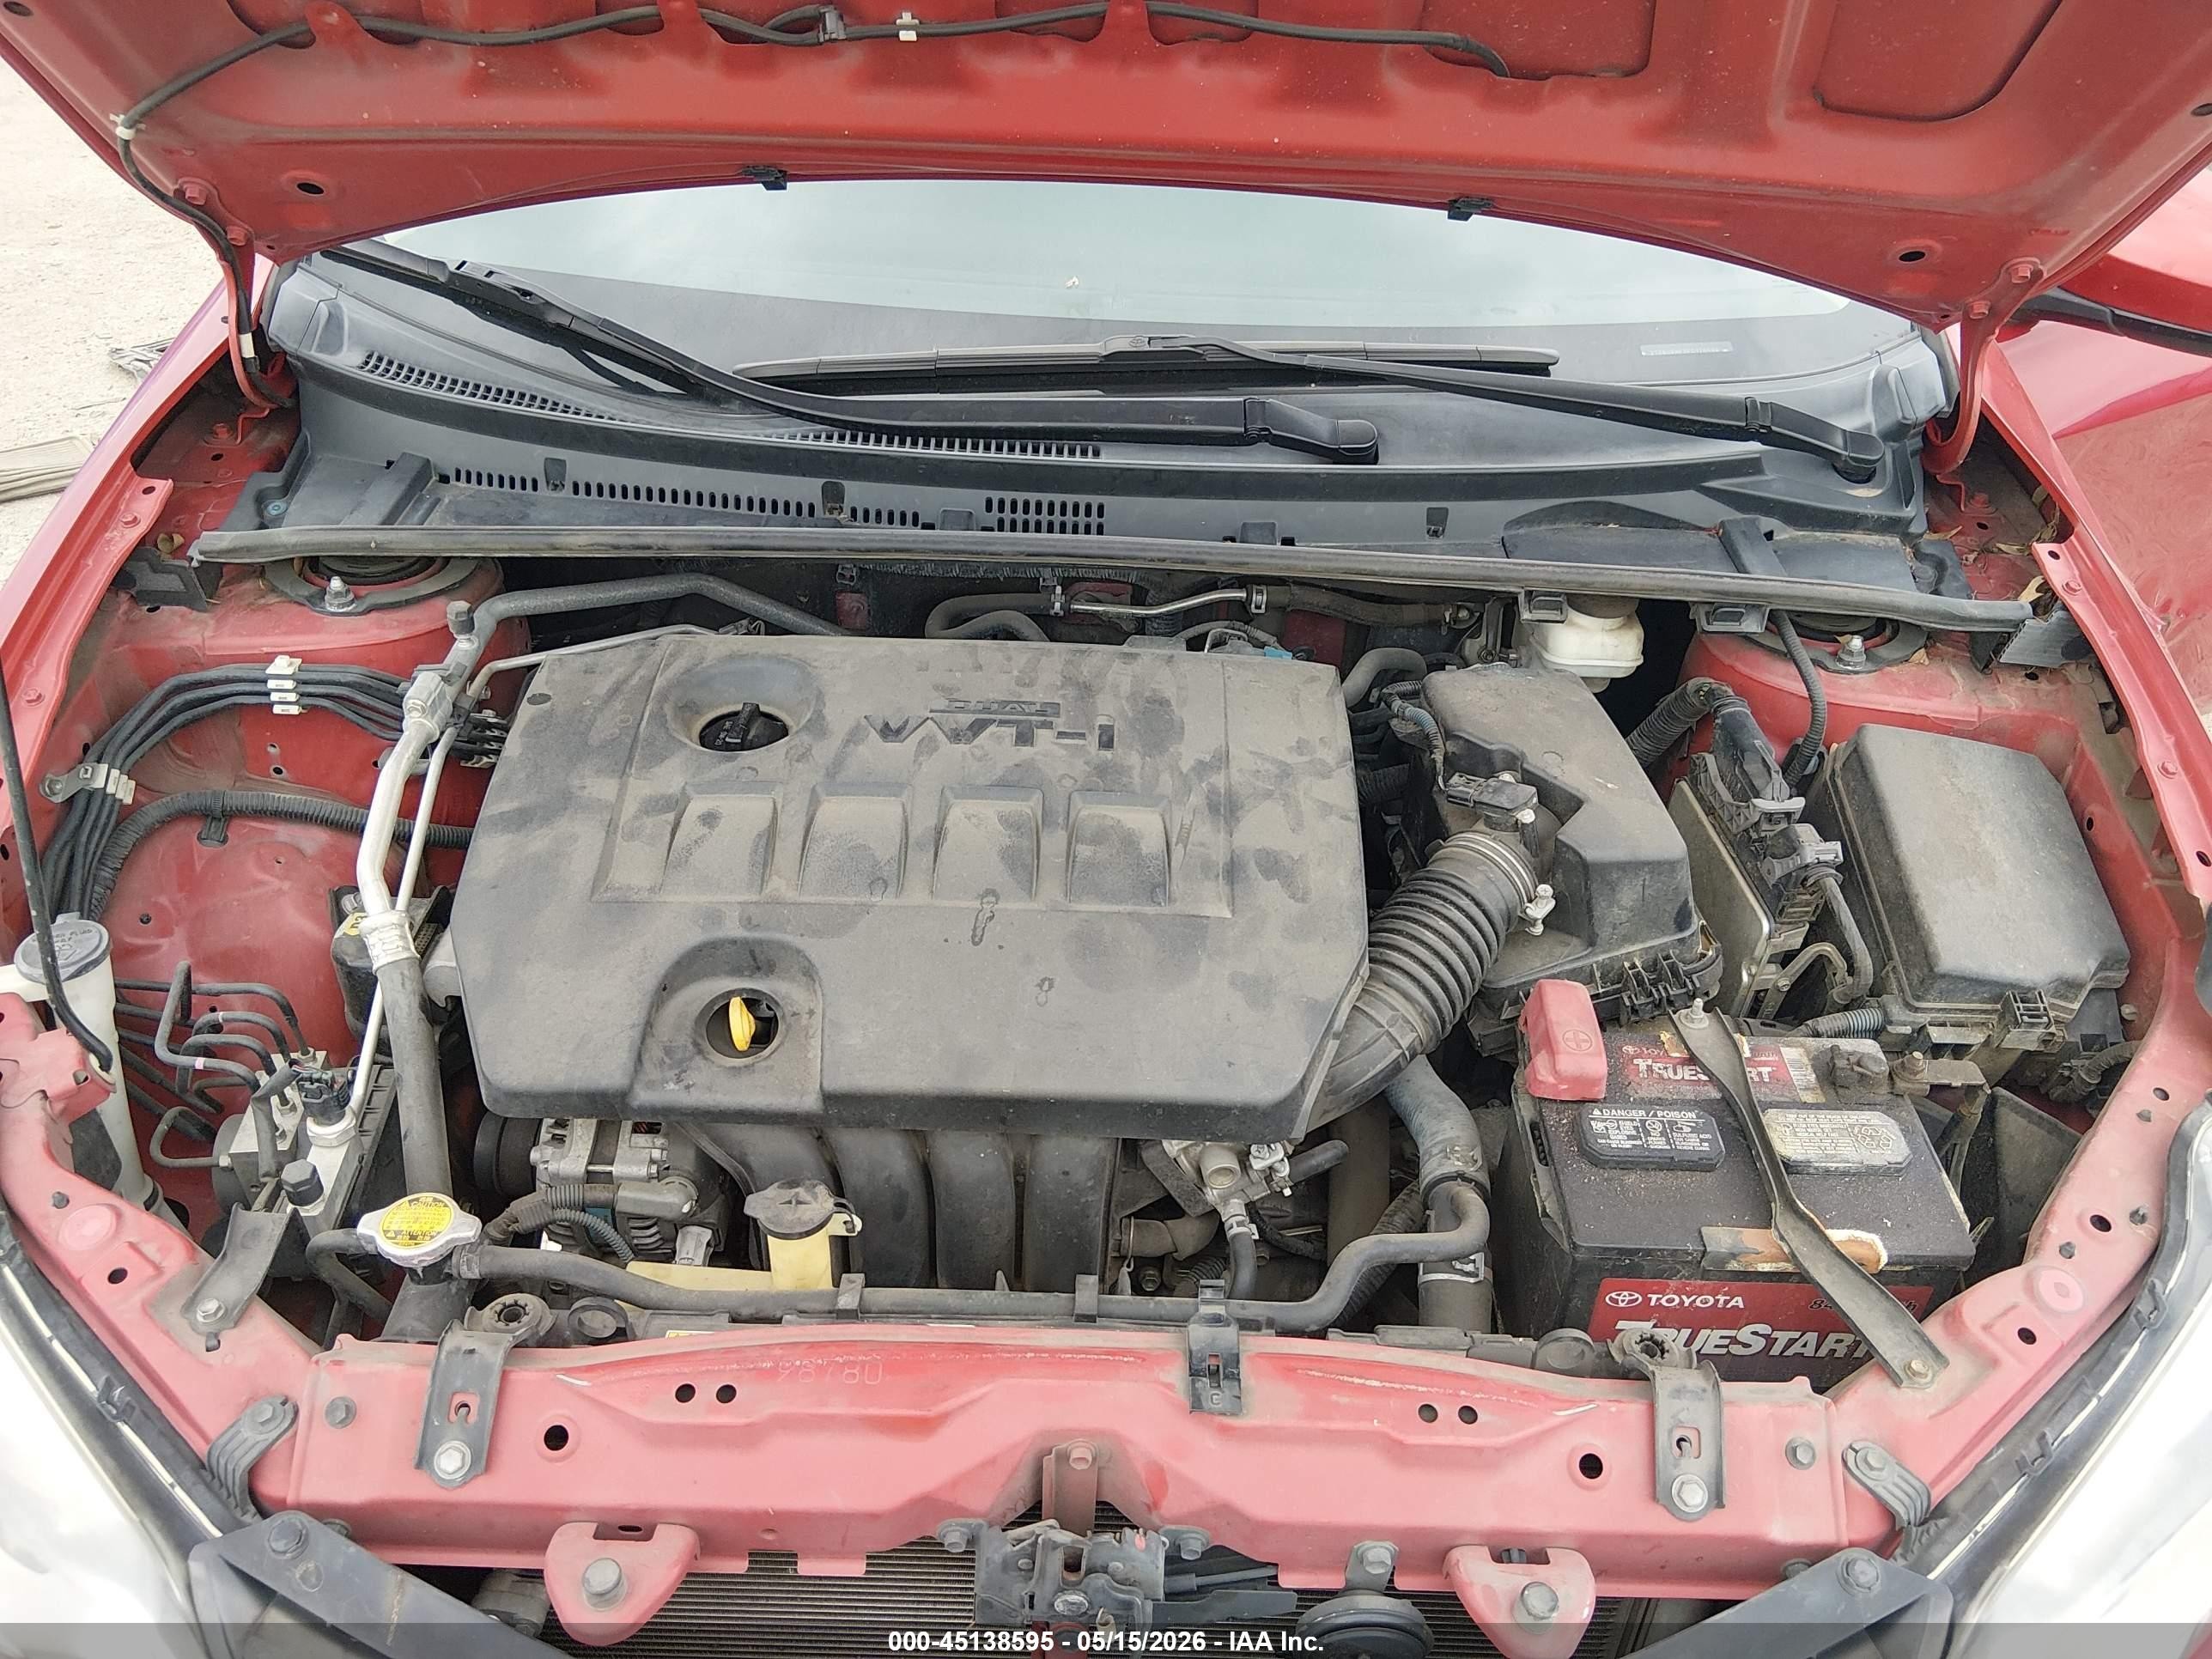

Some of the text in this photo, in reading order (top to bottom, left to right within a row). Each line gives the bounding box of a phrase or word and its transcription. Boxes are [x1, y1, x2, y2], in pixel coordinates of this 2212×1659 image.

[1633, 1057, 1774, 1083] TRUESRT
[1602, 1108, 1647, 1117] DANGER
[1656, 1110, 1697, 1119] POISON
[1647, 1293, 1746, 1310] TOYOTA
